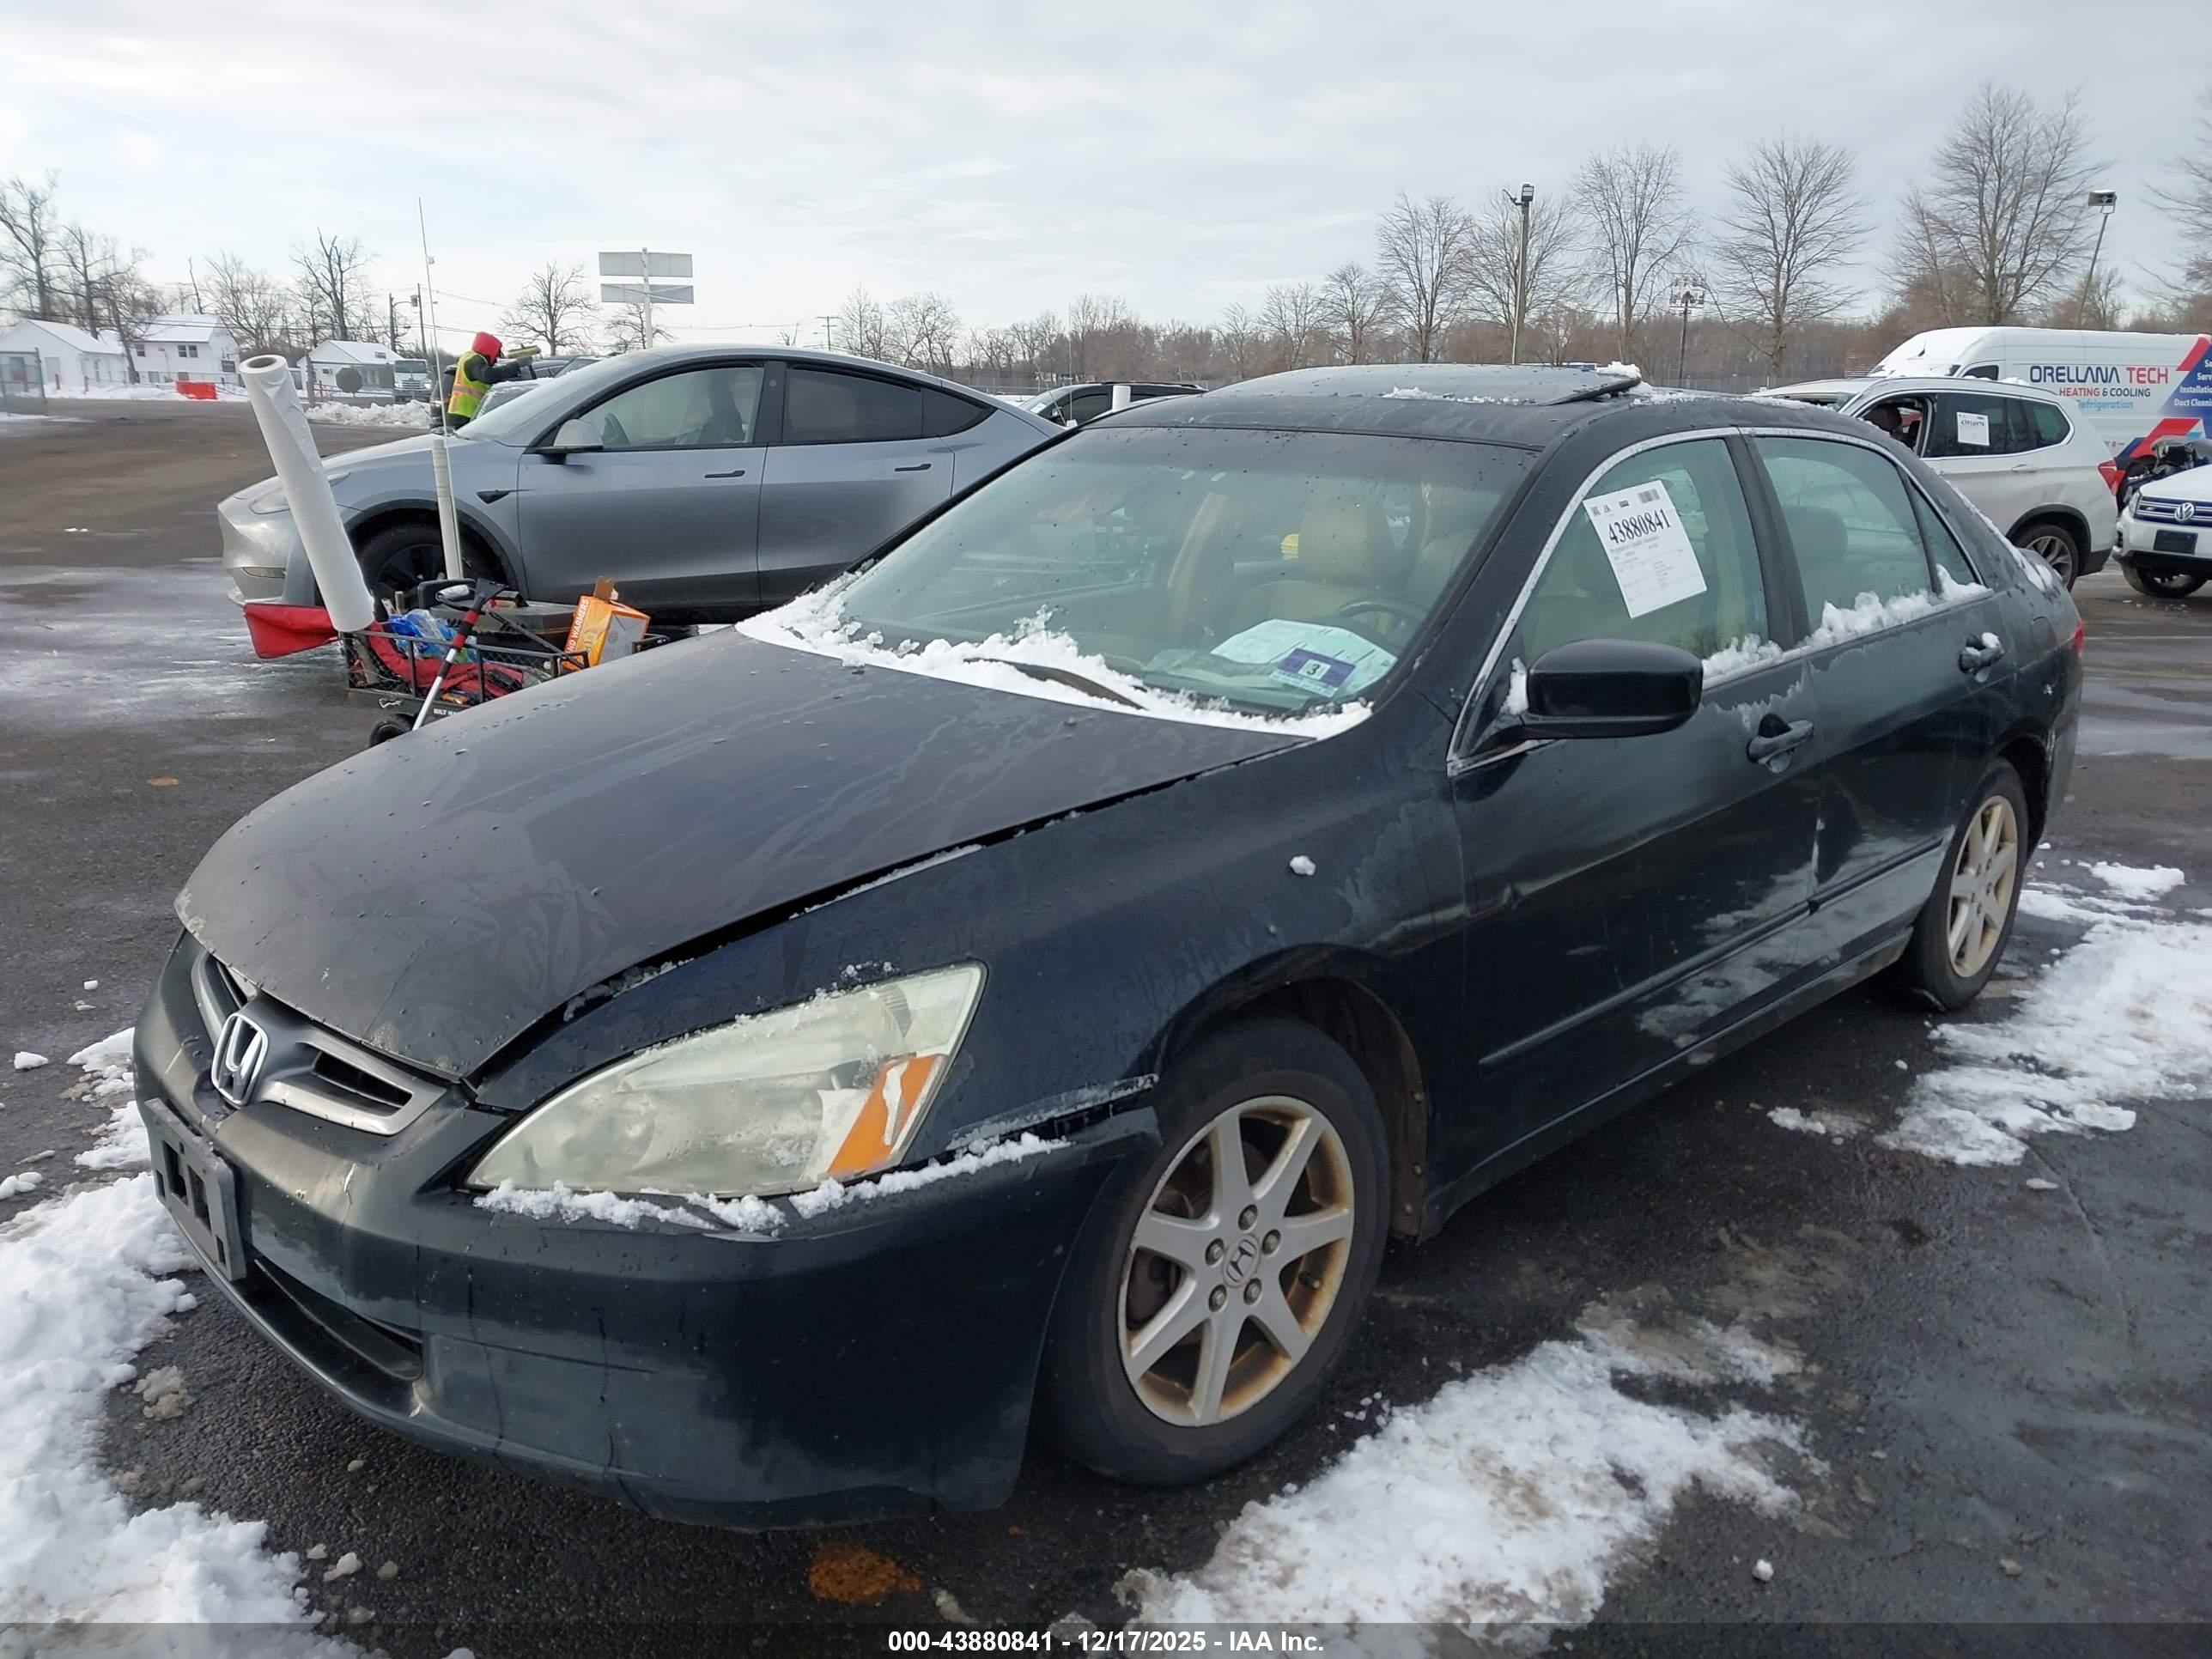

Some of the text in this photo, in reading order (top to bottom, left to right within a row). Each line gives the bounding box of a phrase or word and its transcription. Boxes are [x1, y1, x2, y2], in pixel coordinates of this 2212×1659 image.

[2029, 365, 2169, 385] ORELLANA TECH
[2059, 387, 2151, 398] HEATING & COOLING
[1608, 507, 1671, 544] 43880841
[573, 599, 590, 637] WARMERS
[1306, 664, 1322, 676] 3
